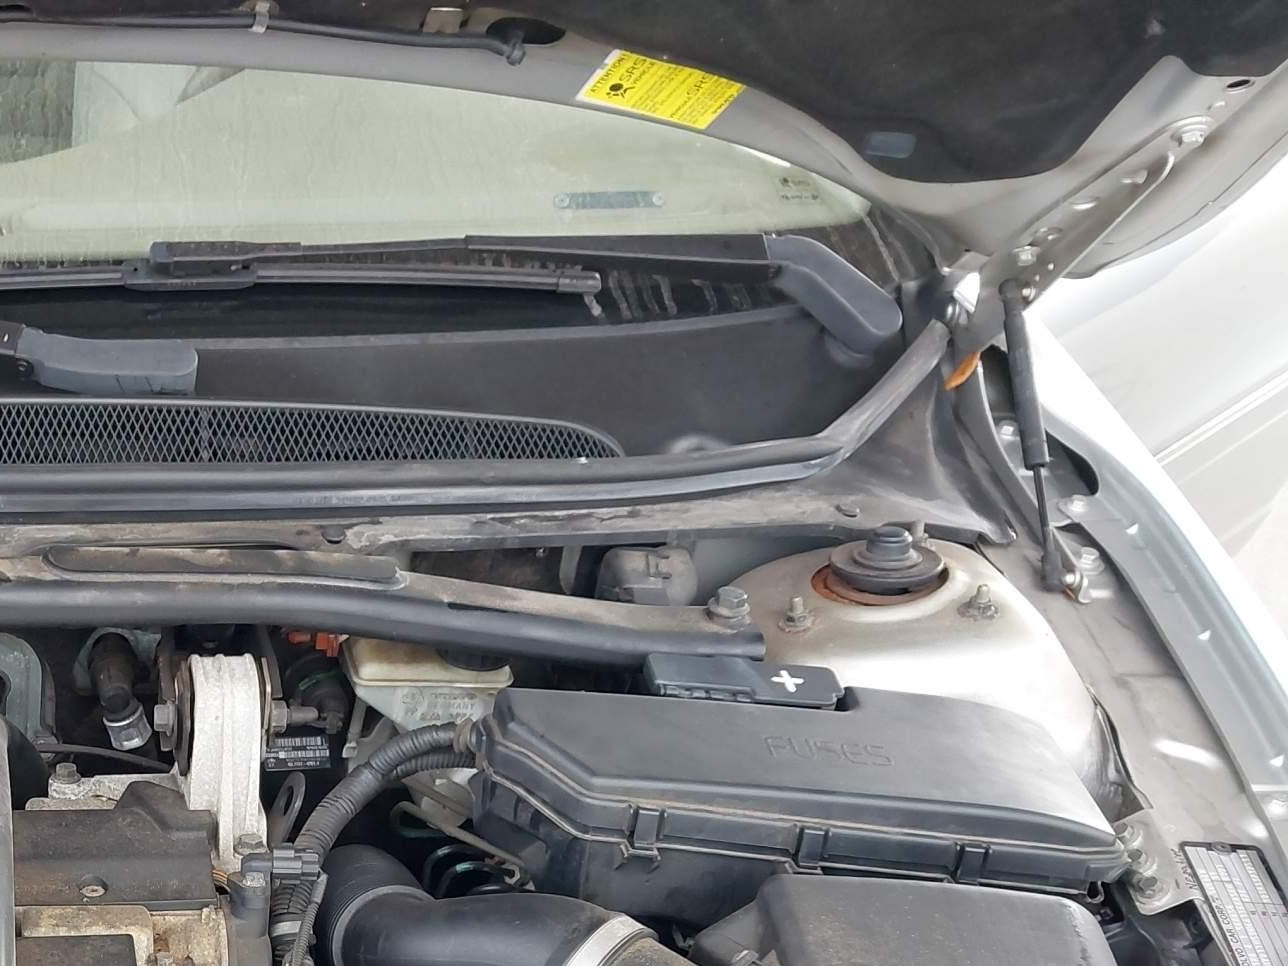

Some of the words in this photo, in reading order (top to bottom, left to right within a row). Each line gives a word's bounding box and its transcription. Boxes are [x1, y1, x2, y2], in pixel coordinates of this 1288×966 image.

[619, 58, 647, 83] SRS
[764, 736, 895, 767] FUSES
[1223, 928, 1239, 944] CAR
